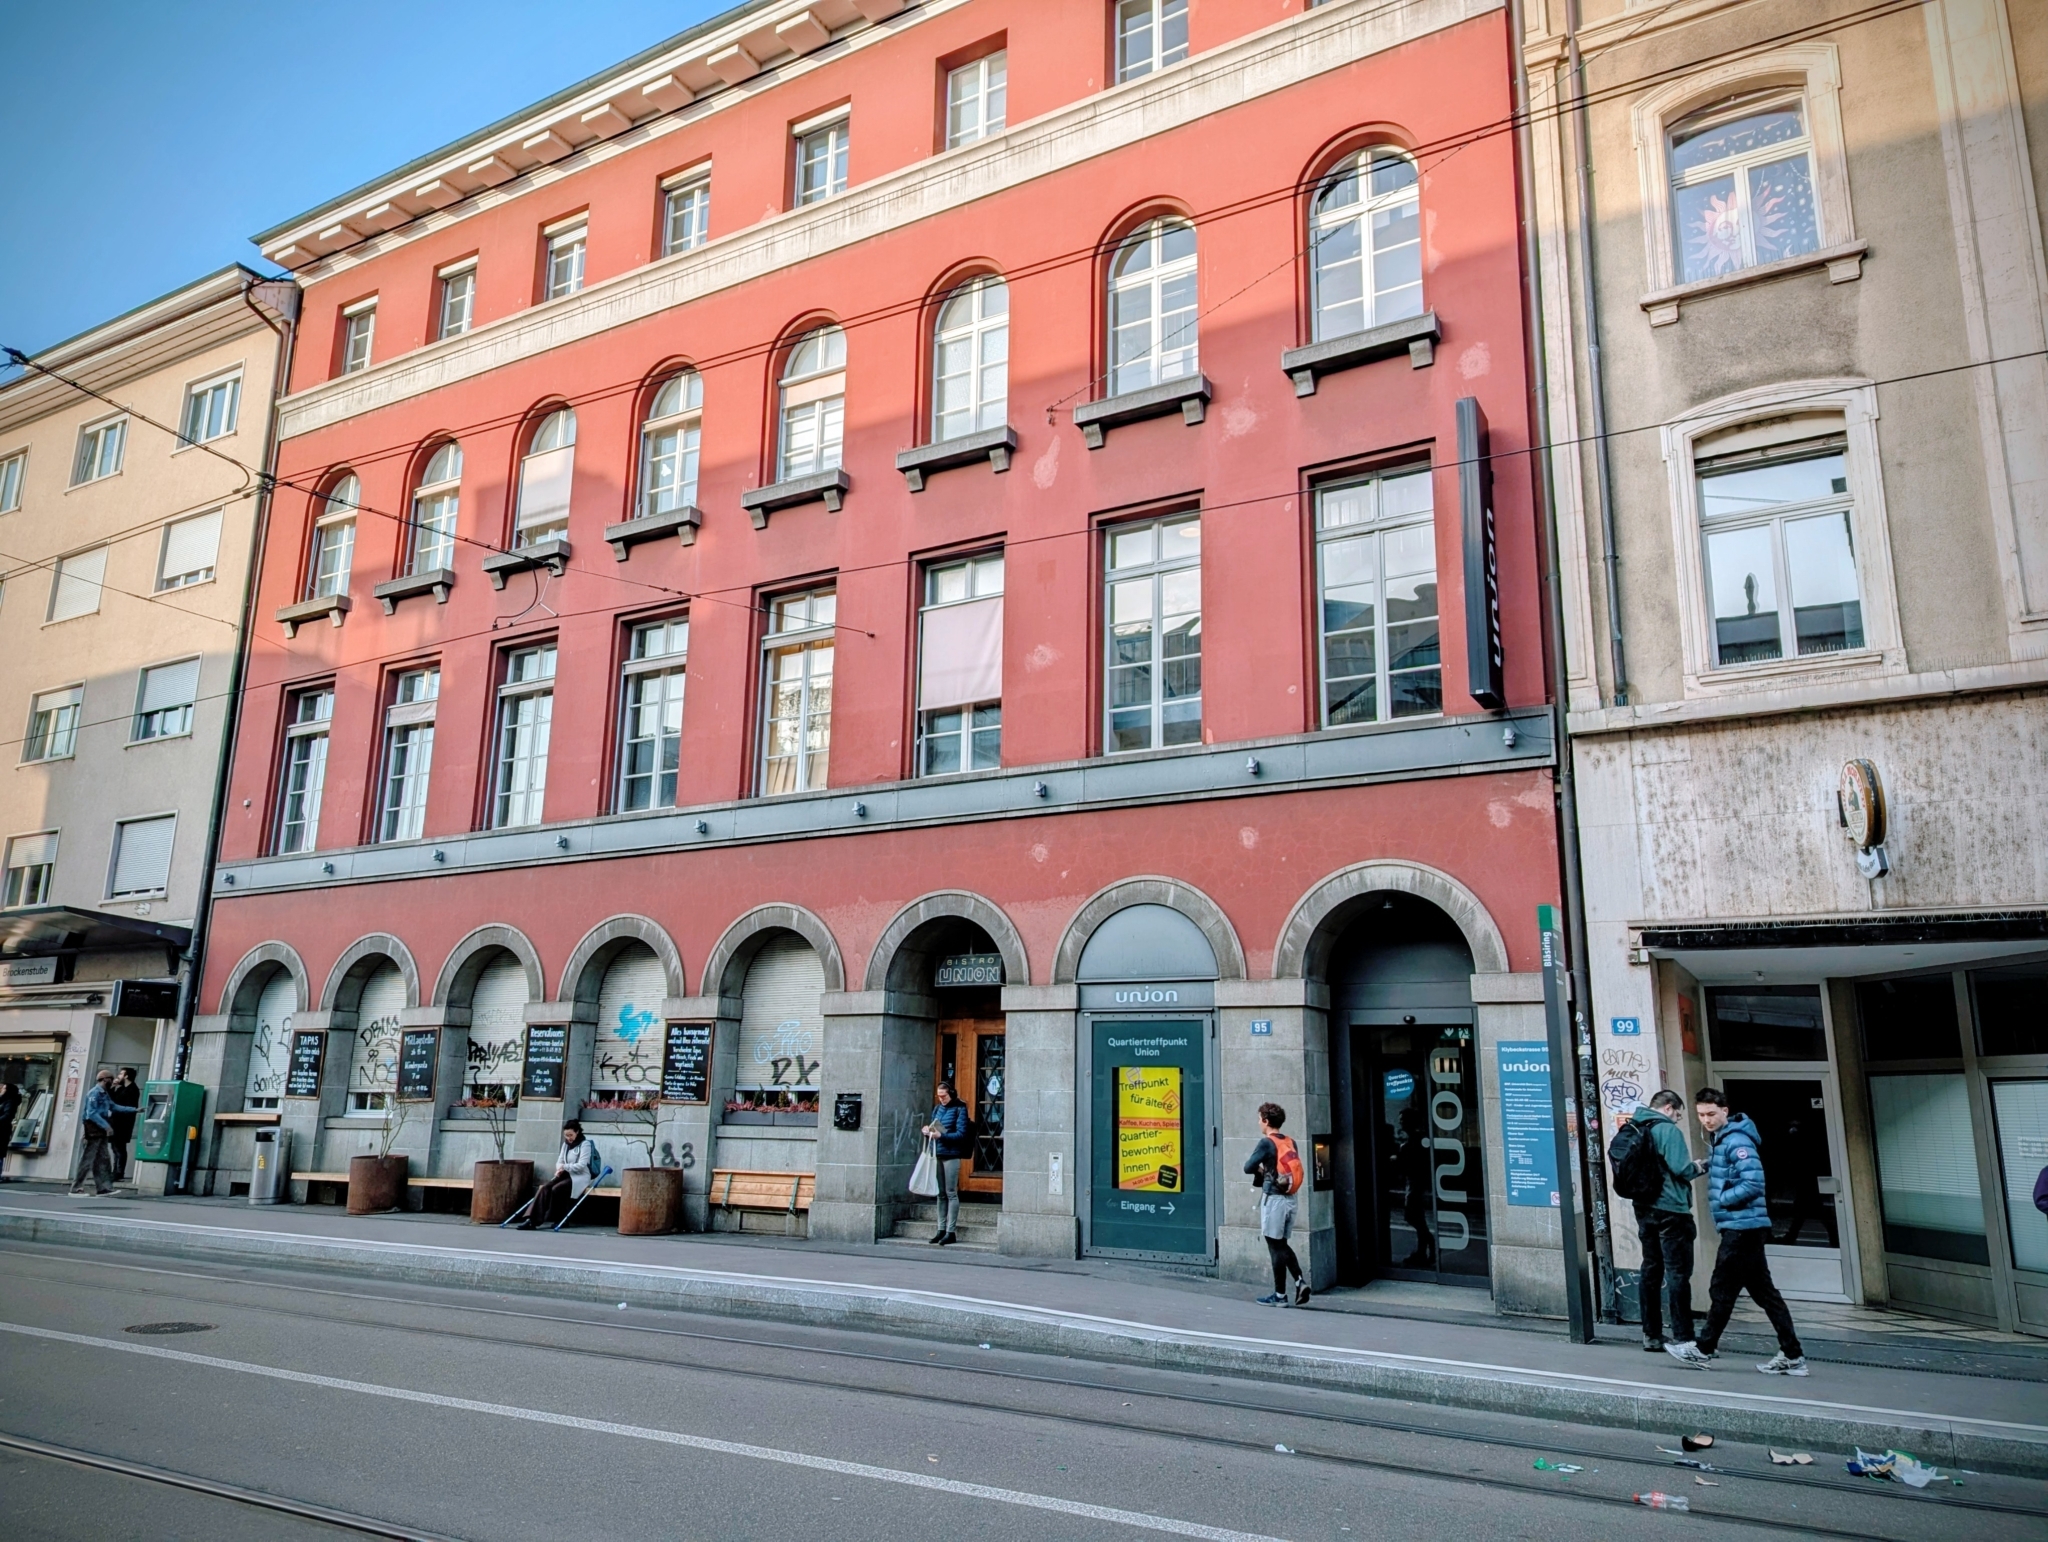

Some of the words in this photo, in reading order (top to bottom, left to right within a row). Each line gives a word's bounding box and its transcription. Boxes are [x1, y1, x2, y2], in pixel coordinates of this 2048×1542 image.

[1486, 508, 1502, 668] union
[1542, 931, 1552, 967] Bläsiring
[946, 957, 995, 966] BISTRO
[3, 967, 48, 977] Brockenstube
[939, 967, 999, 982] UNION
[1115, 985, 1178, 1003] union
[1254, 1022, 1267, 1032] 95
[1616, 1021, 1634, 1032] 99
[300, 1035, 319, 1046] TAPAS
[1108, 1037, 1188, 1048] Quartiertreffpunkt
[1135, 1047, 1160, 1056] Union
[1502, 1060, 1551, 1072] union
[1120, 1077, 1170, 1092] Treffpunkt
[1130, 1093, 1144, 1105] für
[1145, 1096, 1173, 1111] ältere
[1120, 1130, 1162, 1142] Quartier-
[1421, 1047, 1469, 1250] union
[1123, 1163, 1150, 1173] innen
[1120, 1201, 1156, 1213] Eingang
